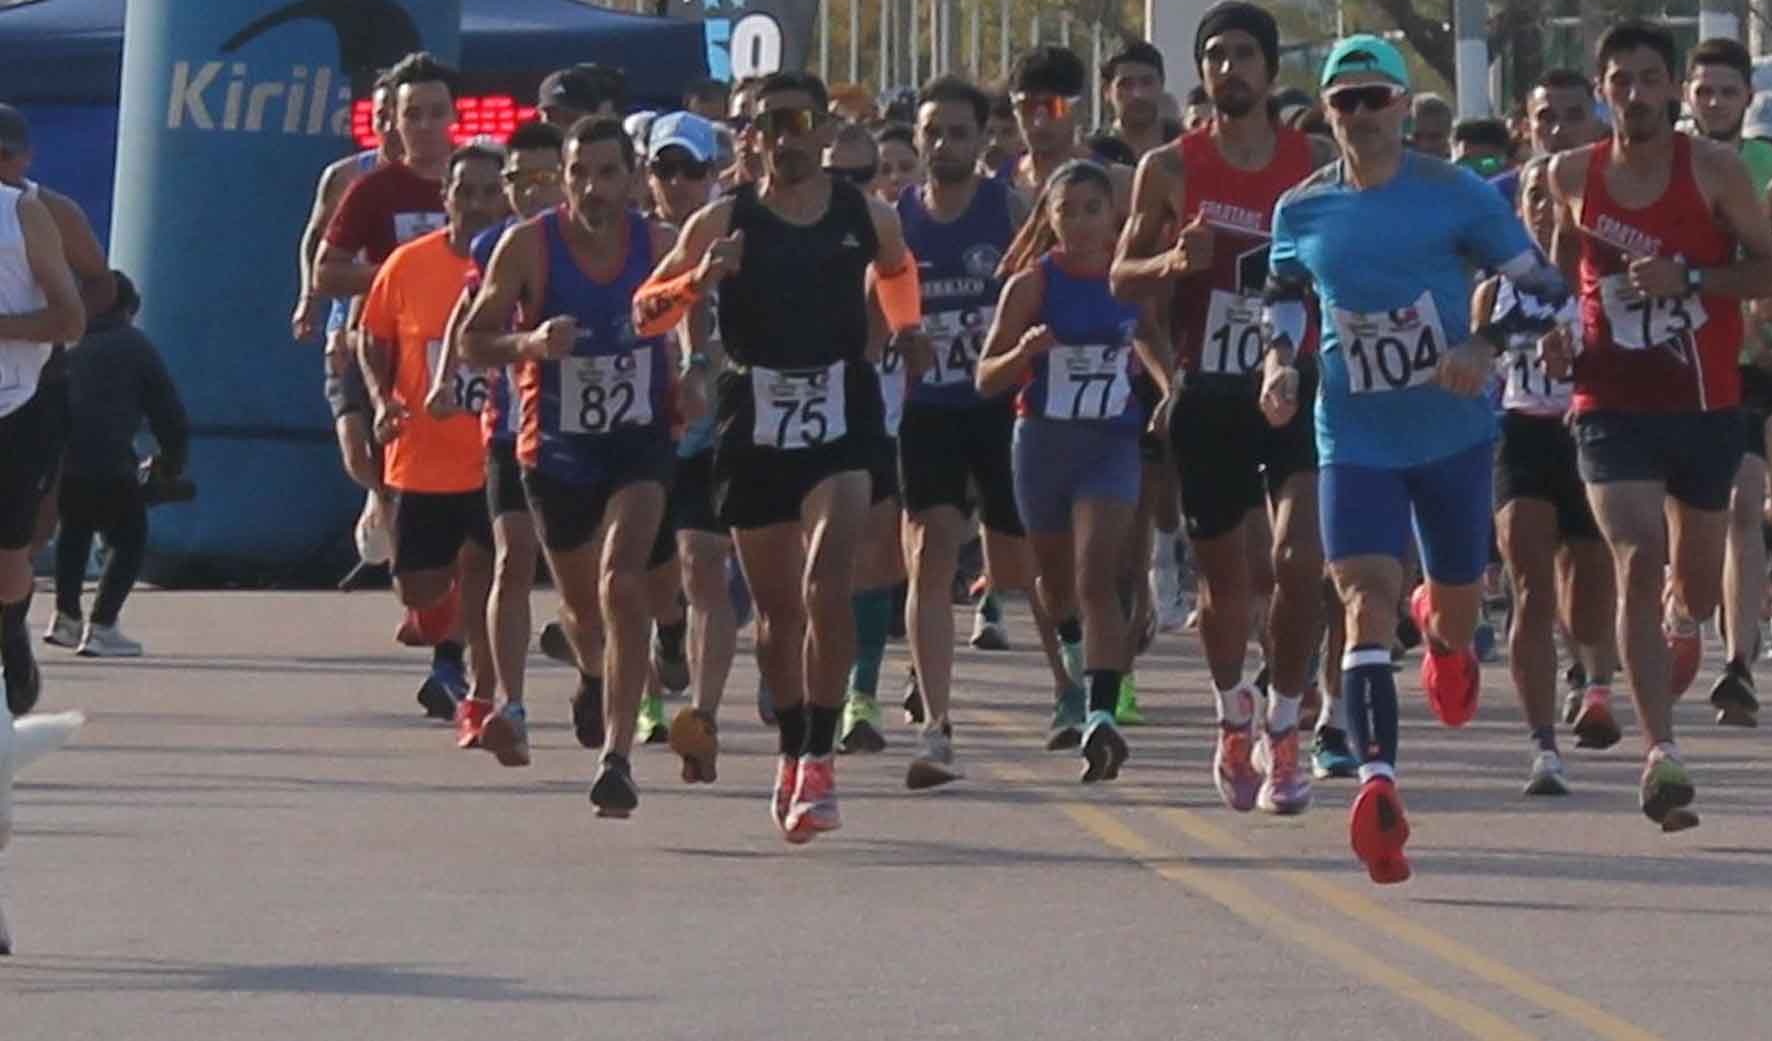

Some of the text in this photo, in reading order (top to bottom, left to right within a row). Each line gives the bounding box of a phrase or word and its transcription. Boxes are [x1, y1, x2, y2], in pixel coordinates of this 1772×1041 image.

[166, 62, 351, 135] Kirila
[1213, 324, 1263, 372] 10
[1350, 324, 1438, 390] 104
[580, 380, 634, 430] 82
[1069, 373, 1116, 418] 77
[772, 398, 828, 448] 75
